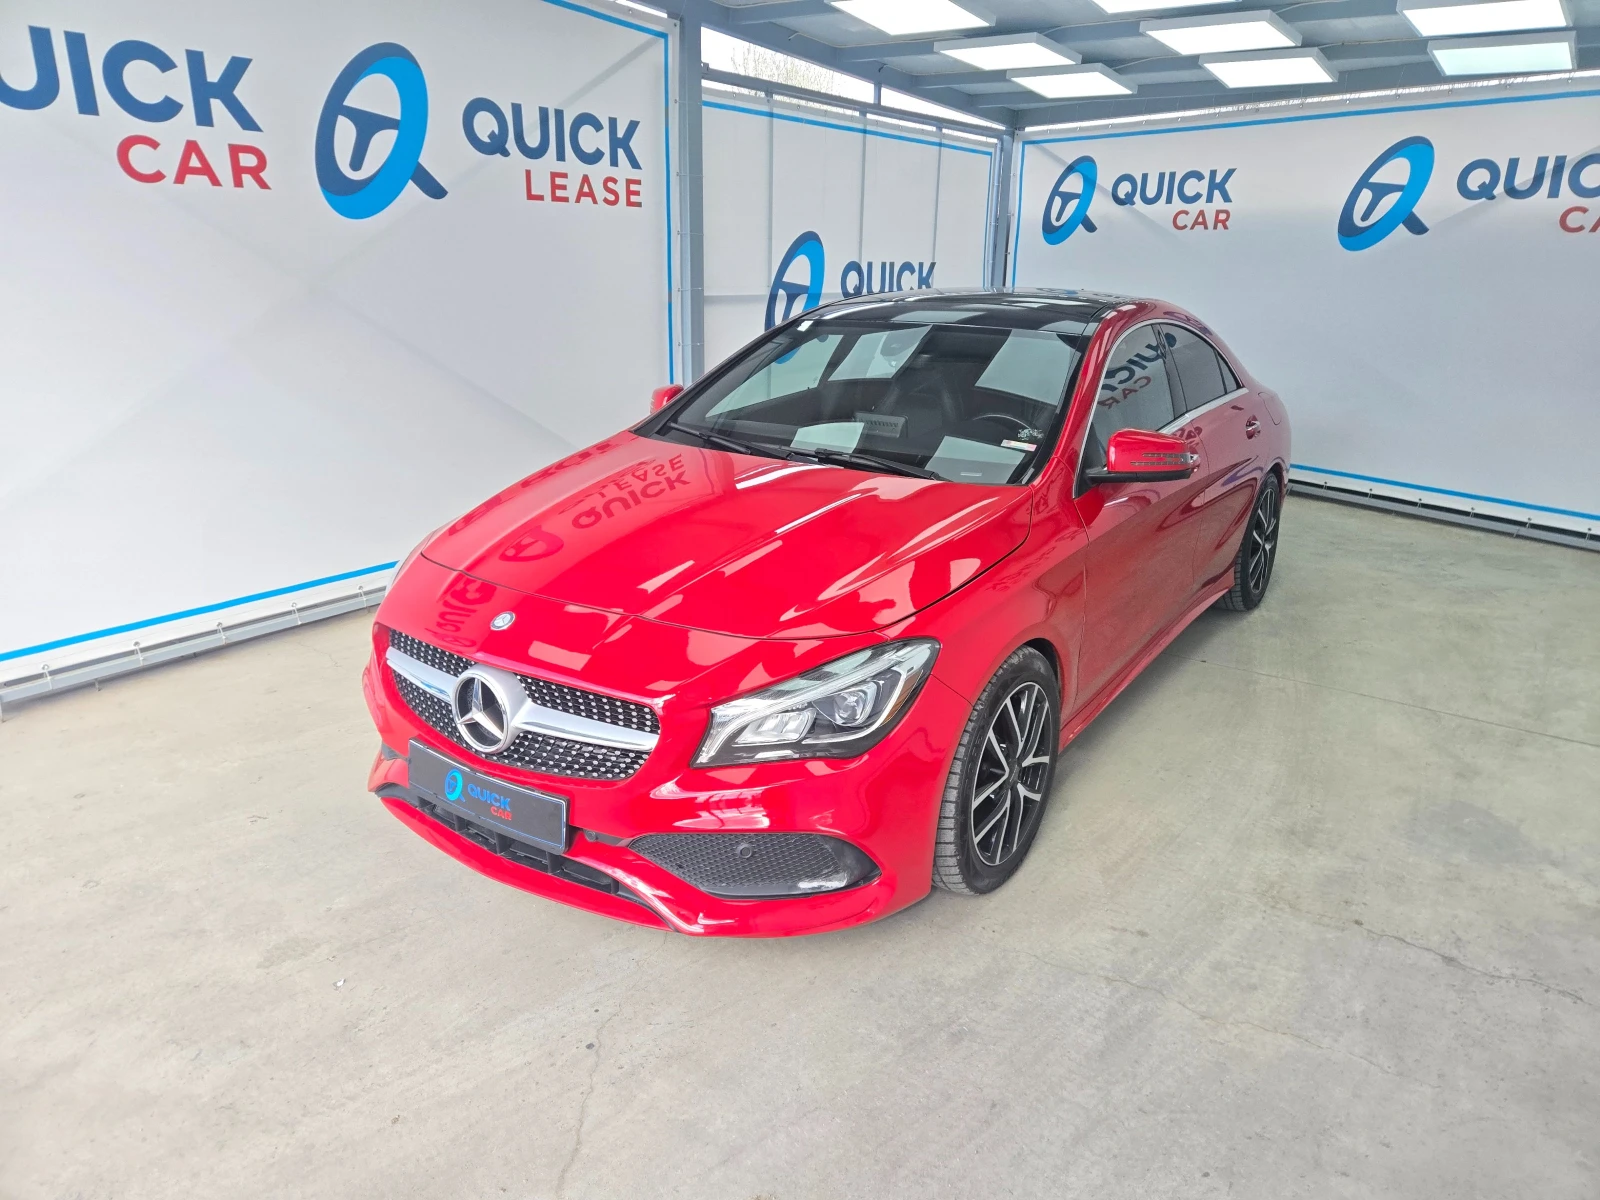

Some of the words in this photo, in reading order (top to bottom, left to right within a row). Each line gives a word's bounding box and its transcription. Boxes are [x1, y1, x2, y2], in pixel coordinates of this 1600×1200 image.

[462, 97, 643, 170] QUICK
[116, 134, 272, 190] CAR
[525, 169, 643, 208] LEASE
[1111, 168, 1238, 206] QUICK
[1172, 209, 1231, 231] CAR
[840, 260, 937, 298] QUICK
[467, 783, 511, 811] QUICK
[490, 805, 512, 821] CAR
